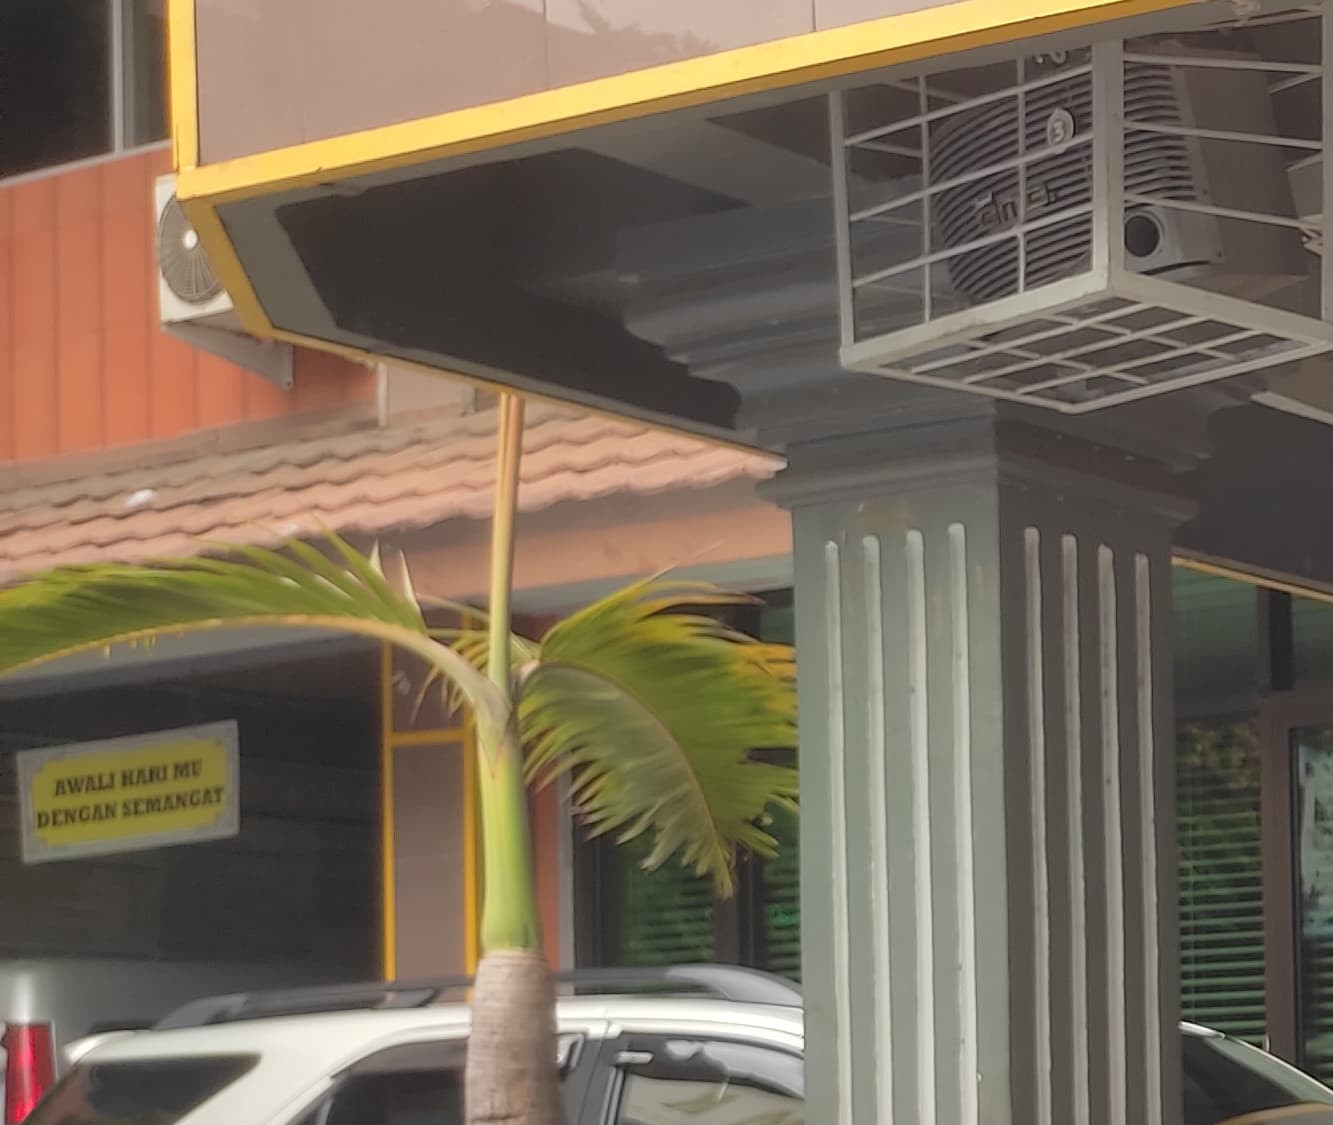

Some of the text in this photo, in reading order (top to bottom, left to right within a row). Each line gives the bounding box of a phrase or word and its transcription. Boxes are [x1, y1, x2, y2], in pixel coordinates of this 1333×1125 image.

[54, 758, 203, 797] AWALI HARI MU
[36, 787, 224, 829] DENGAN SEMANGAT
